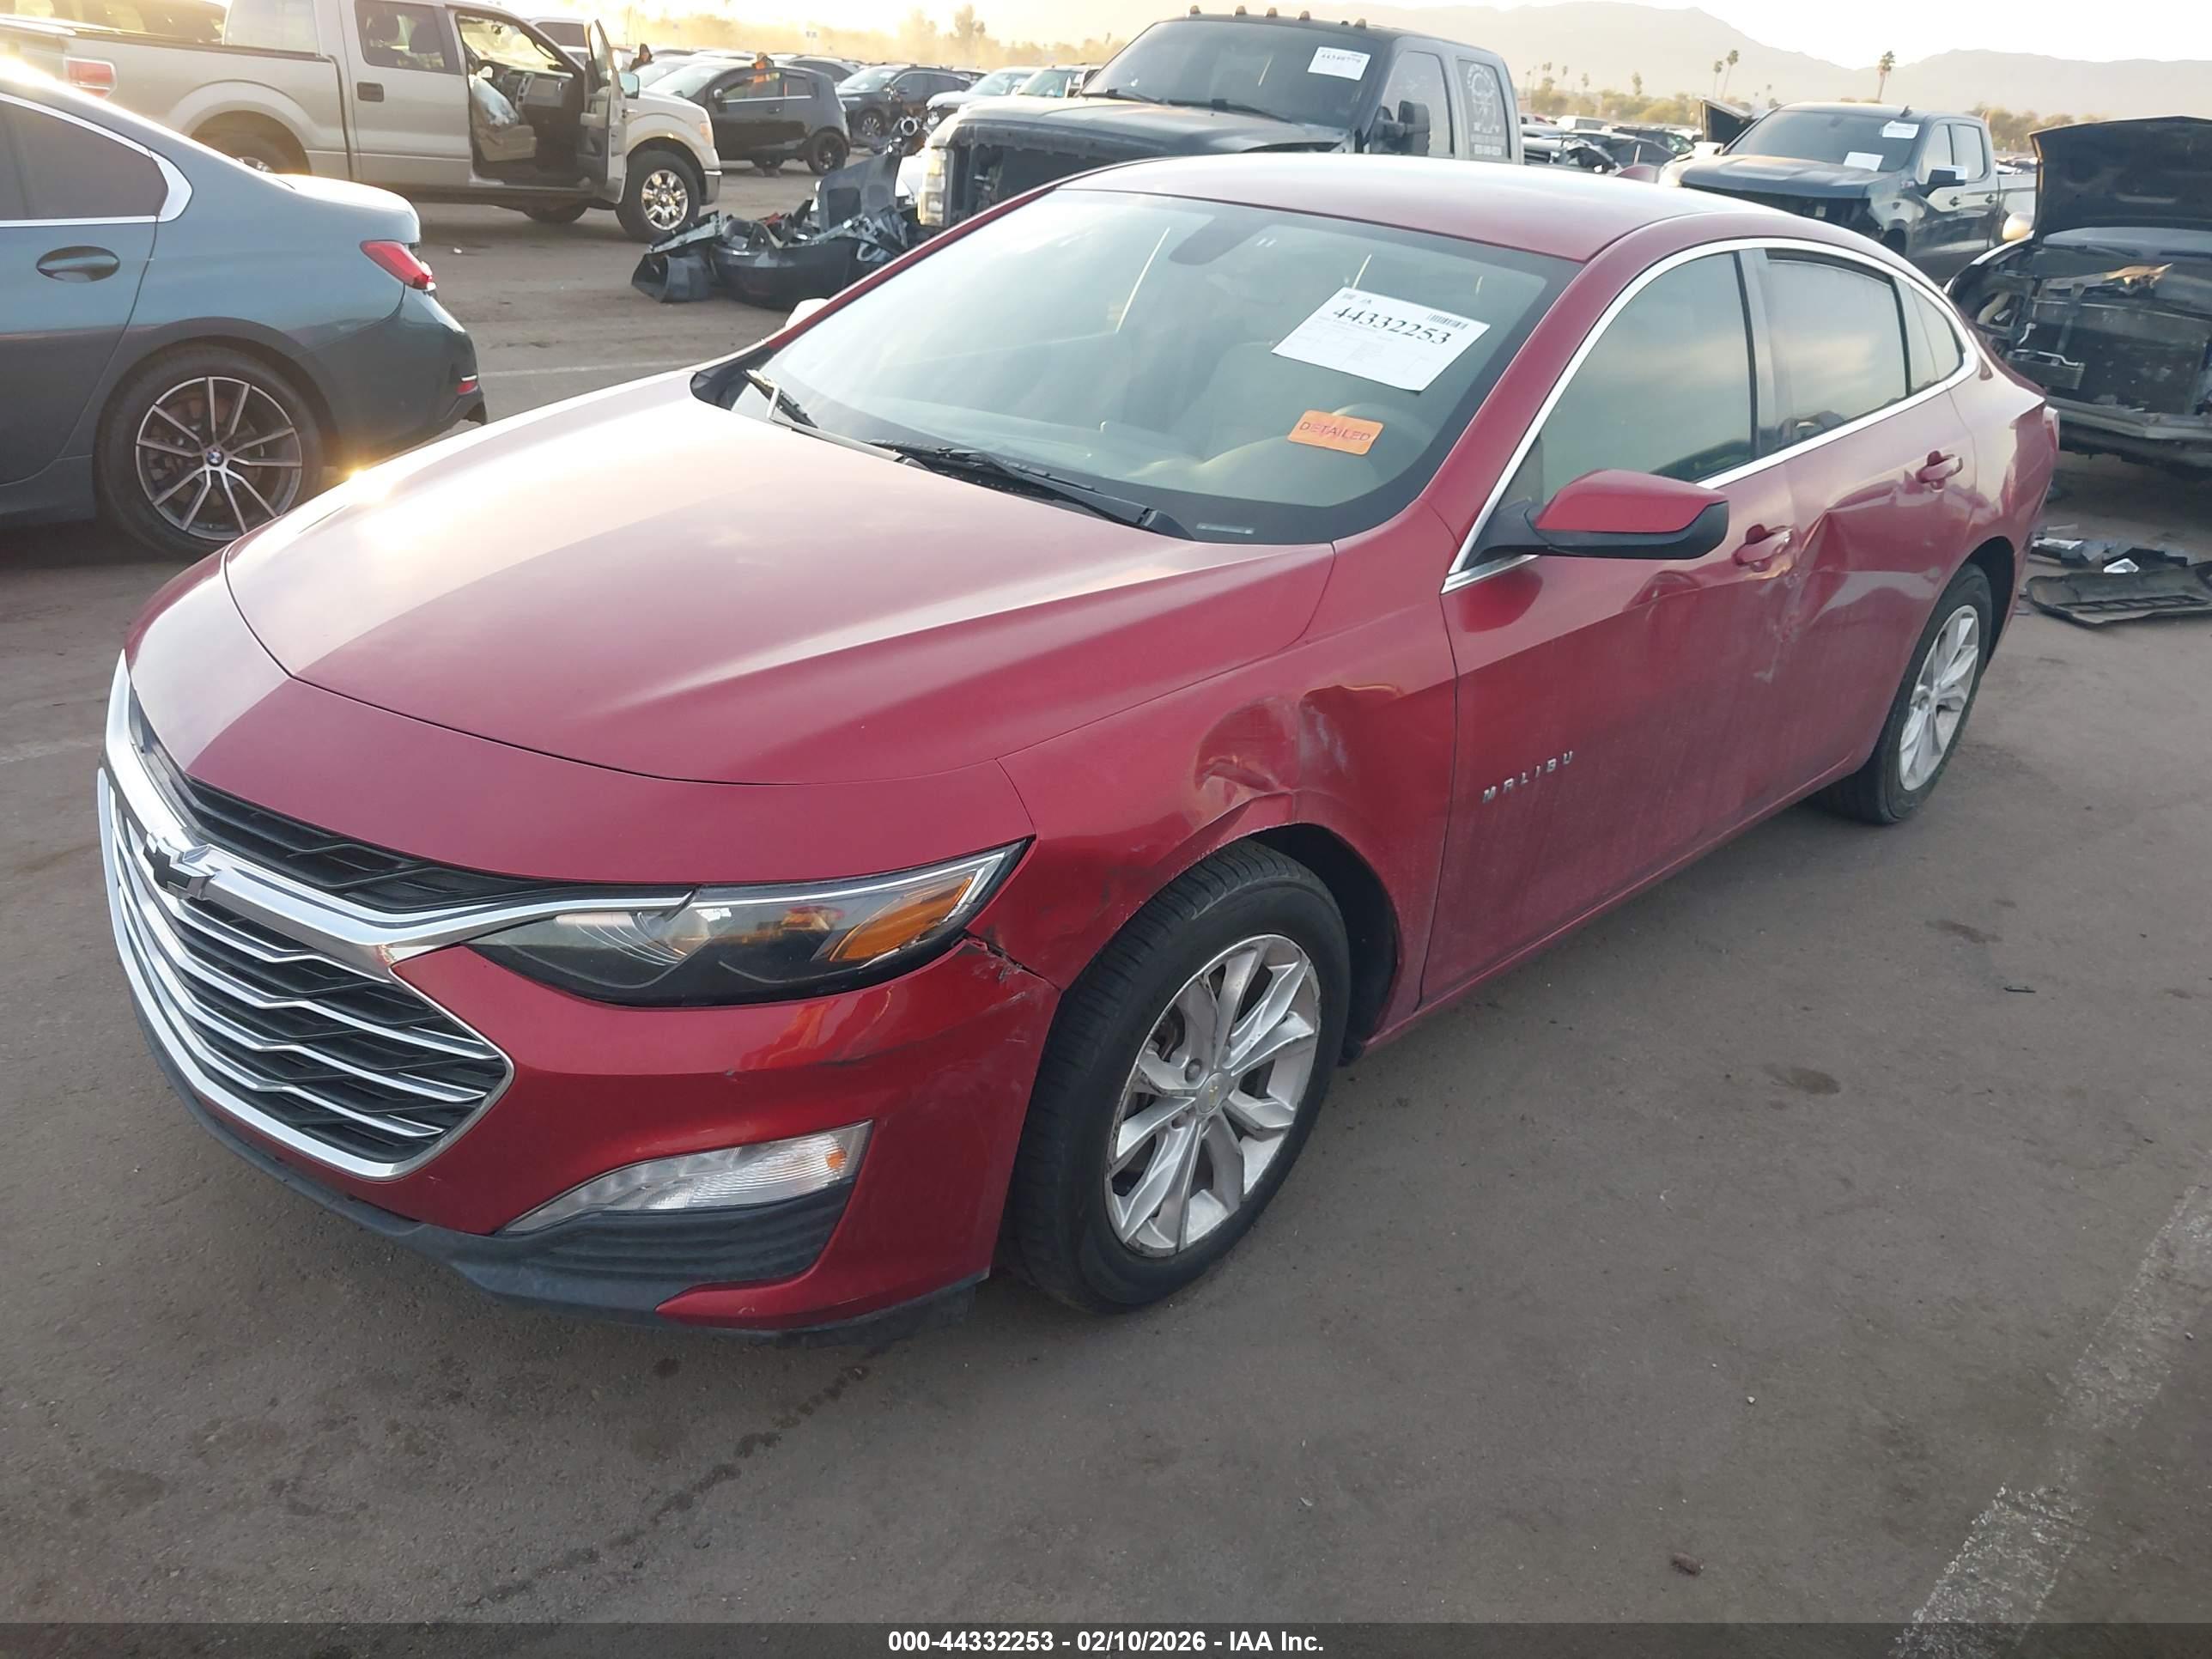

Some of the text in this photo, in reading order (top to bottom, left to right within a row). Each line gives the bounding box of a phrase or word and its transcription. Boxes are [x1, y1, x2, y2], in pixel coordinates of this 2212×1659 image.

[1333, 306, 1452, 345] 44332253
[1299, 421, 1371, 441] DETAILED
[1482, 750, 1574, 805] MALIBU
